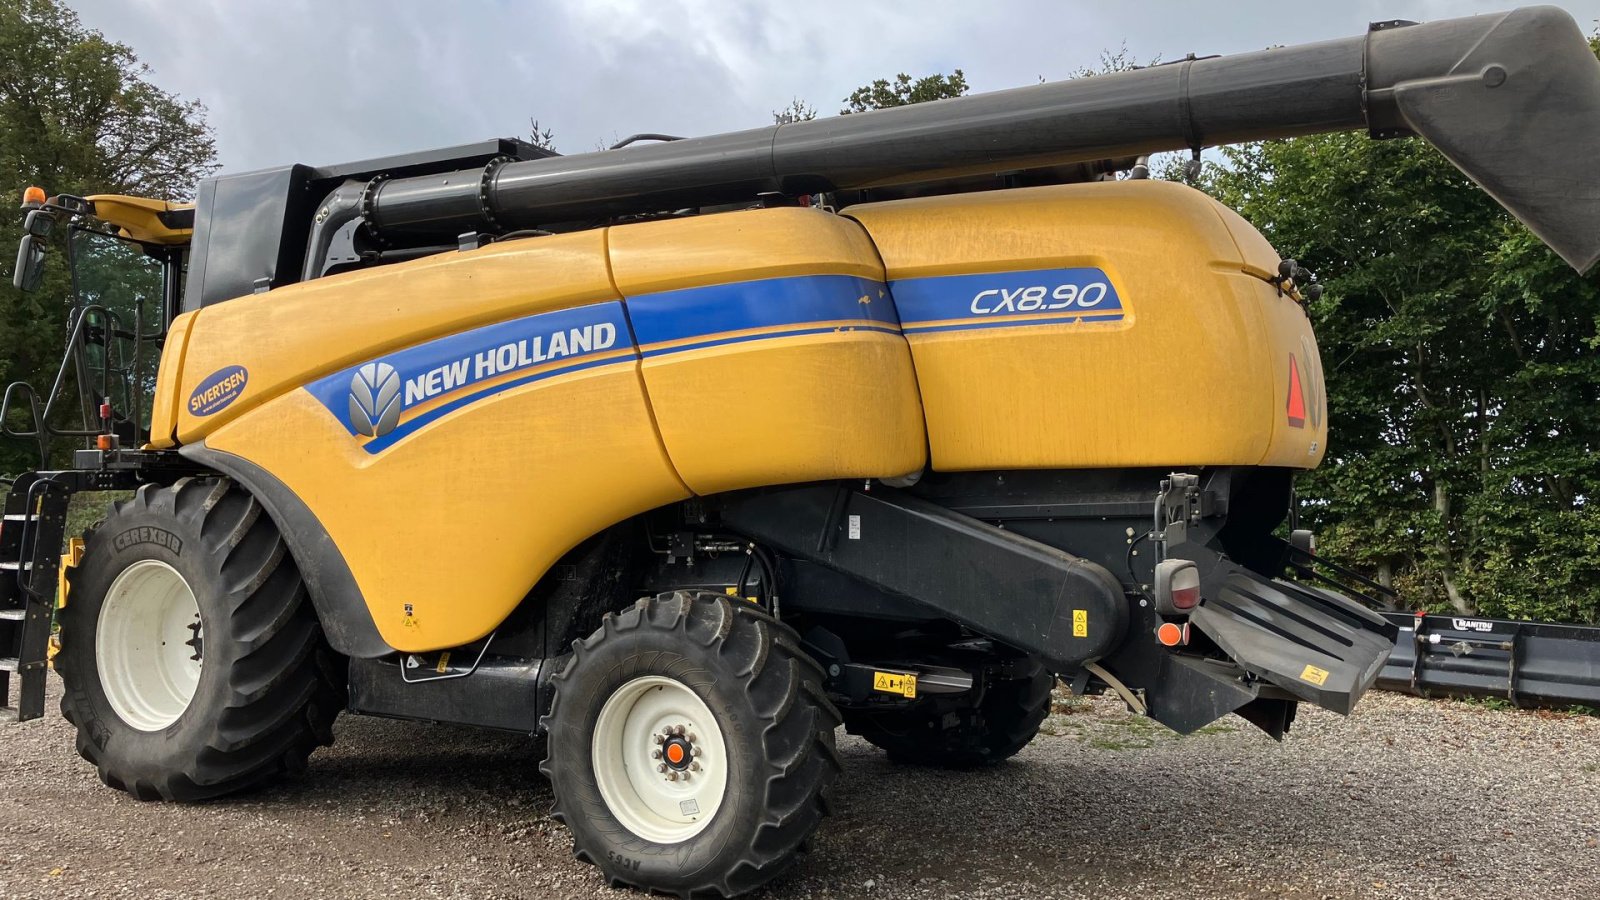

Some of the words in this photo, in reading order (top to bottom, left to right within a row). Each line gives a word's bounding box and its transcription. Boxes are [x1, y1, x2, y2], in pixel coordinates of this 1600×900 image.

[970, 282, 1108, 315] CX8.90
[404, 356, 471, 406] NEW
[474, 322, 616, 380] HOLLAND
[191, 369, 245, 411] SIVERTSEN
[115, 526, 181, 554] CEREXBIB
[1458, 619, 1493, 630] MANITOU
[607, 850, 641, 872] AC65
